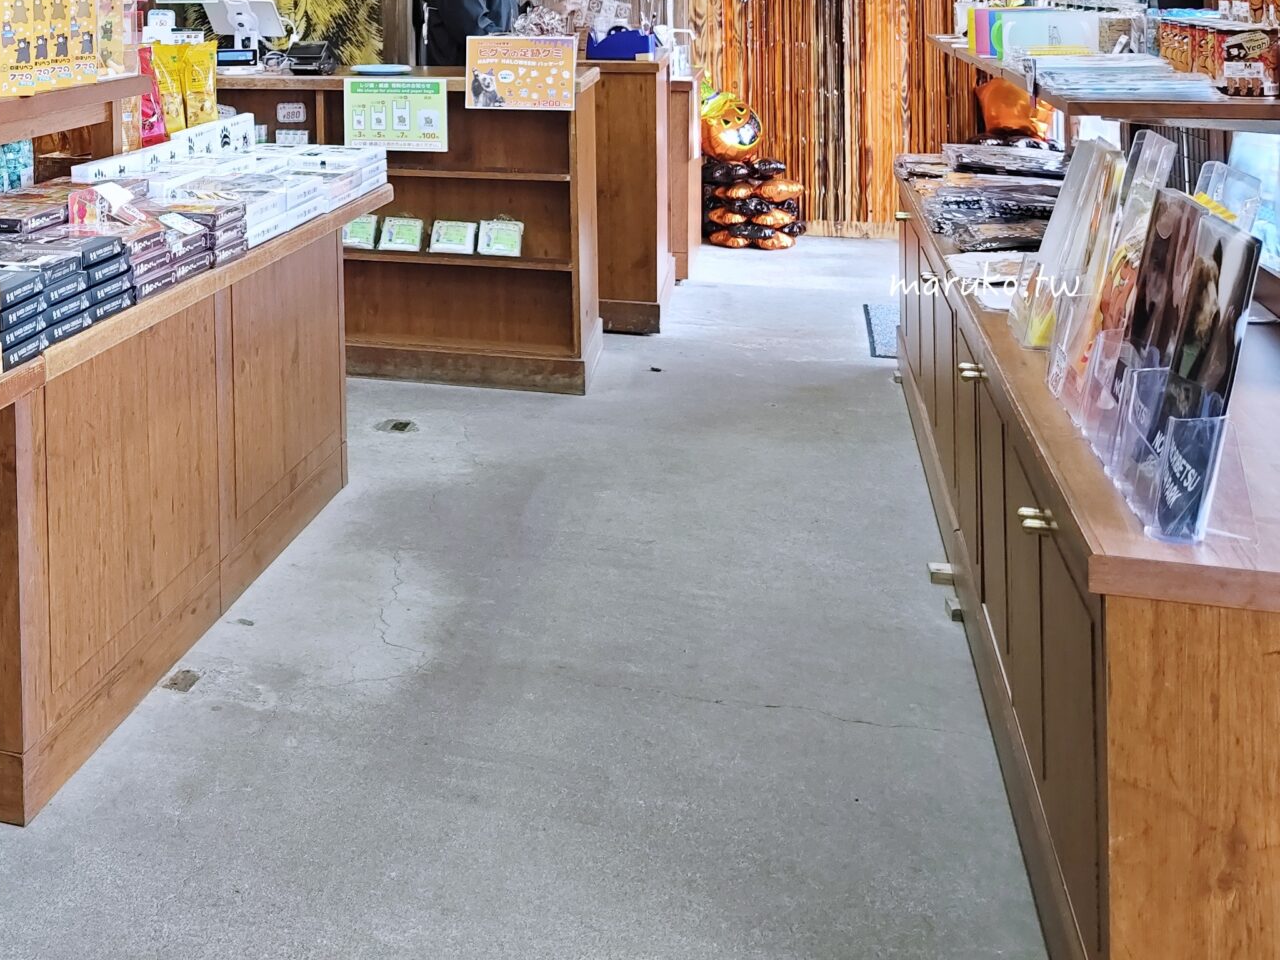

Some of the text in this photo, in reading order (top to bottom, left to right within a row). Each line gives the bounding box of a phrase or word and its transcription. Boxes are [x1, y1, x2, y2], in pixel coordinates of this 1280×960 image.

[479, 48, 562, 59] ヒグマの足跡グミ
[1246, 41, 1269, 54] Yeah!
